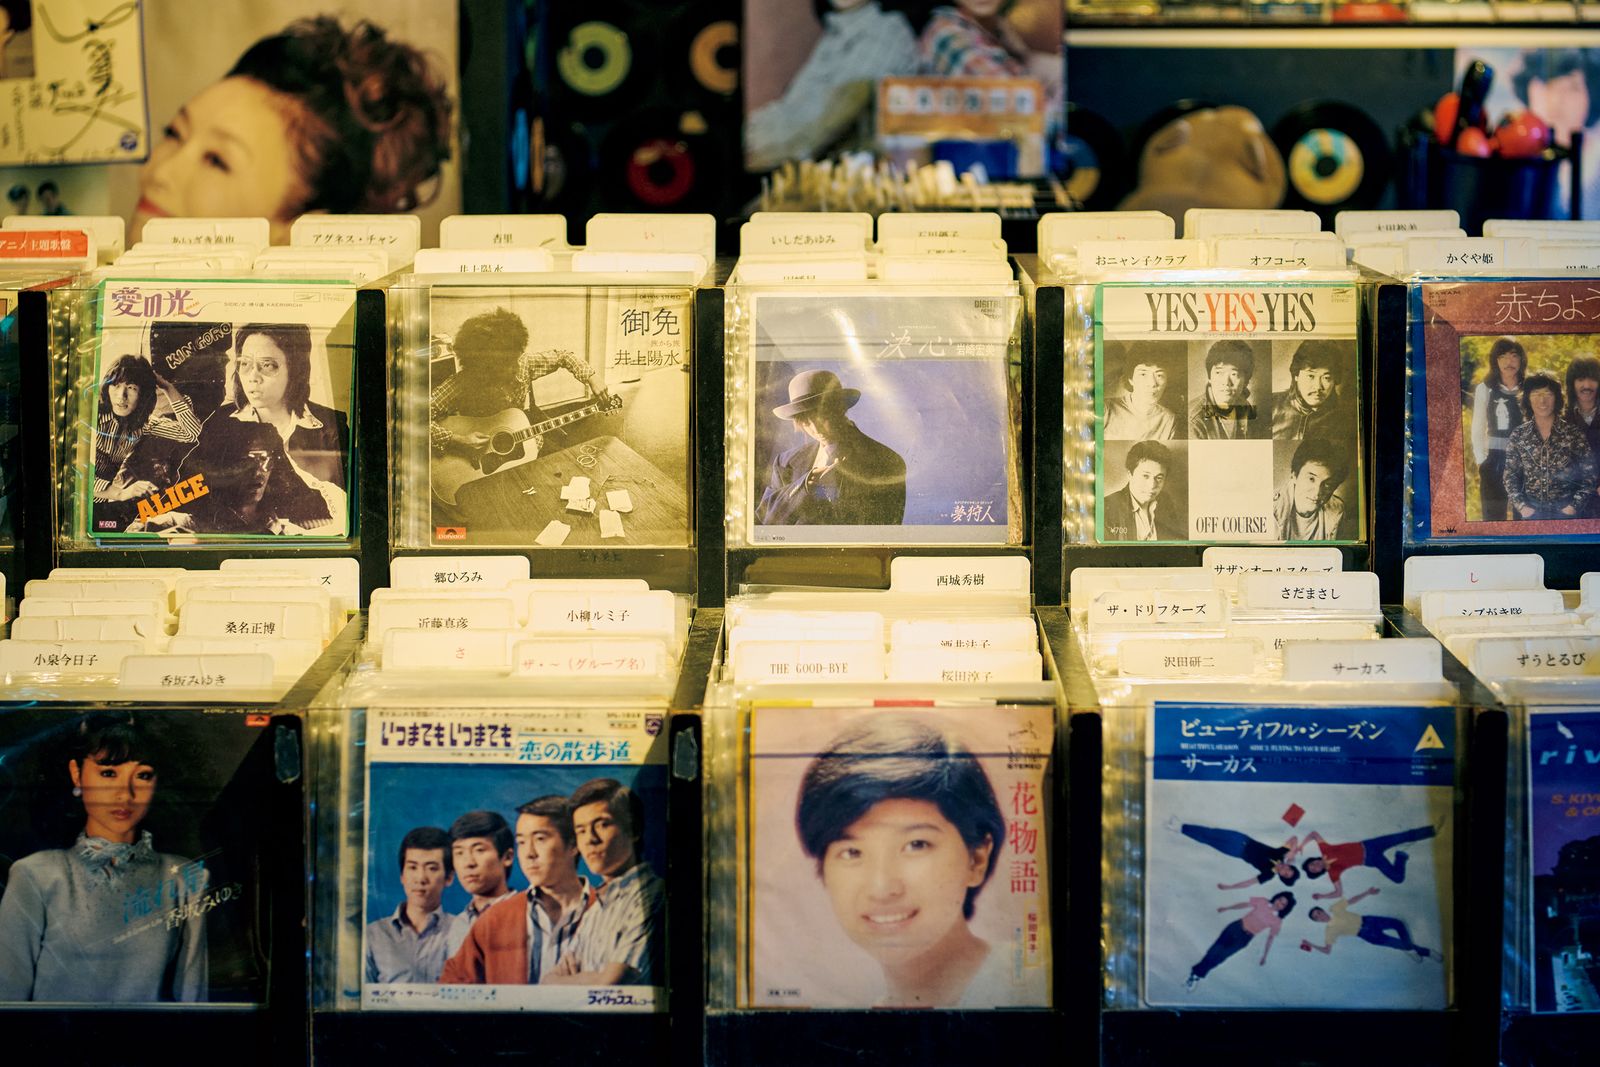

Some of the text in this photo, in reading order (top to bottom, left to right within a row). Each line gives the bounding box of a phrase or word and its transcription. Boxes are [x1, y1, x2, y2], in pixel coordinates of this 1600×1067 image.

[313, 233, 399, 245] アグネス・チャン
[493, 233, 514, 244] 杏里
[771, 234, 836, 246] いしだあゆみ
[1095, 254, 1188, 267] おニャン子クラブ
[1250, 256, 1307, 267] オフコース
[1446, 253, 1494, 265] かぐや姫
[111, 287, 202, 319] 愛の光
[621, 308, 680, 337] 御免
[614, 349, 681, 367] 井上陽水
[135, 473, 210, 524] ALICE
[950, 504, 996, 523] 夢狩人
[1196, 517, 1267, 533] OFF COURSE
[434, 571, 483, 584] 郷ひろみ
[936, 573, 985, 586] 西城秀樹
[1280, 586, 1341, 600] さだまさし
[566, 610, 631, 622] 小柳ルミ子
[1107, 603, 1207, 617] ザ・ドリフターズ
[225, 621, 276, 635] 桑名正博
[418, 617, 469, 629] 近藤真彦
[34, 653, 99, 667] 小泉今日子
[454, 647, 467, 660] さ
[1517, 653, 1586, 667] ずうとるび
[770, 662, 849, 674] THE GOOD-BYE
[1164, 655, 1216, 668] 沢田研二
[1333, 662, 1388, 675] サーカス
[160, 674, 226, 687] 香坂みゆき
[941, 669, 994, 682] 桜田淳子
[1181, 719, 1387, 741] ビューティフル・シーズン
[519, 741, 632, 762] 恋の散歩道
[1181, 753, 1258, 774] サーカス
[1009, 781, 1040, 894] 花物語
